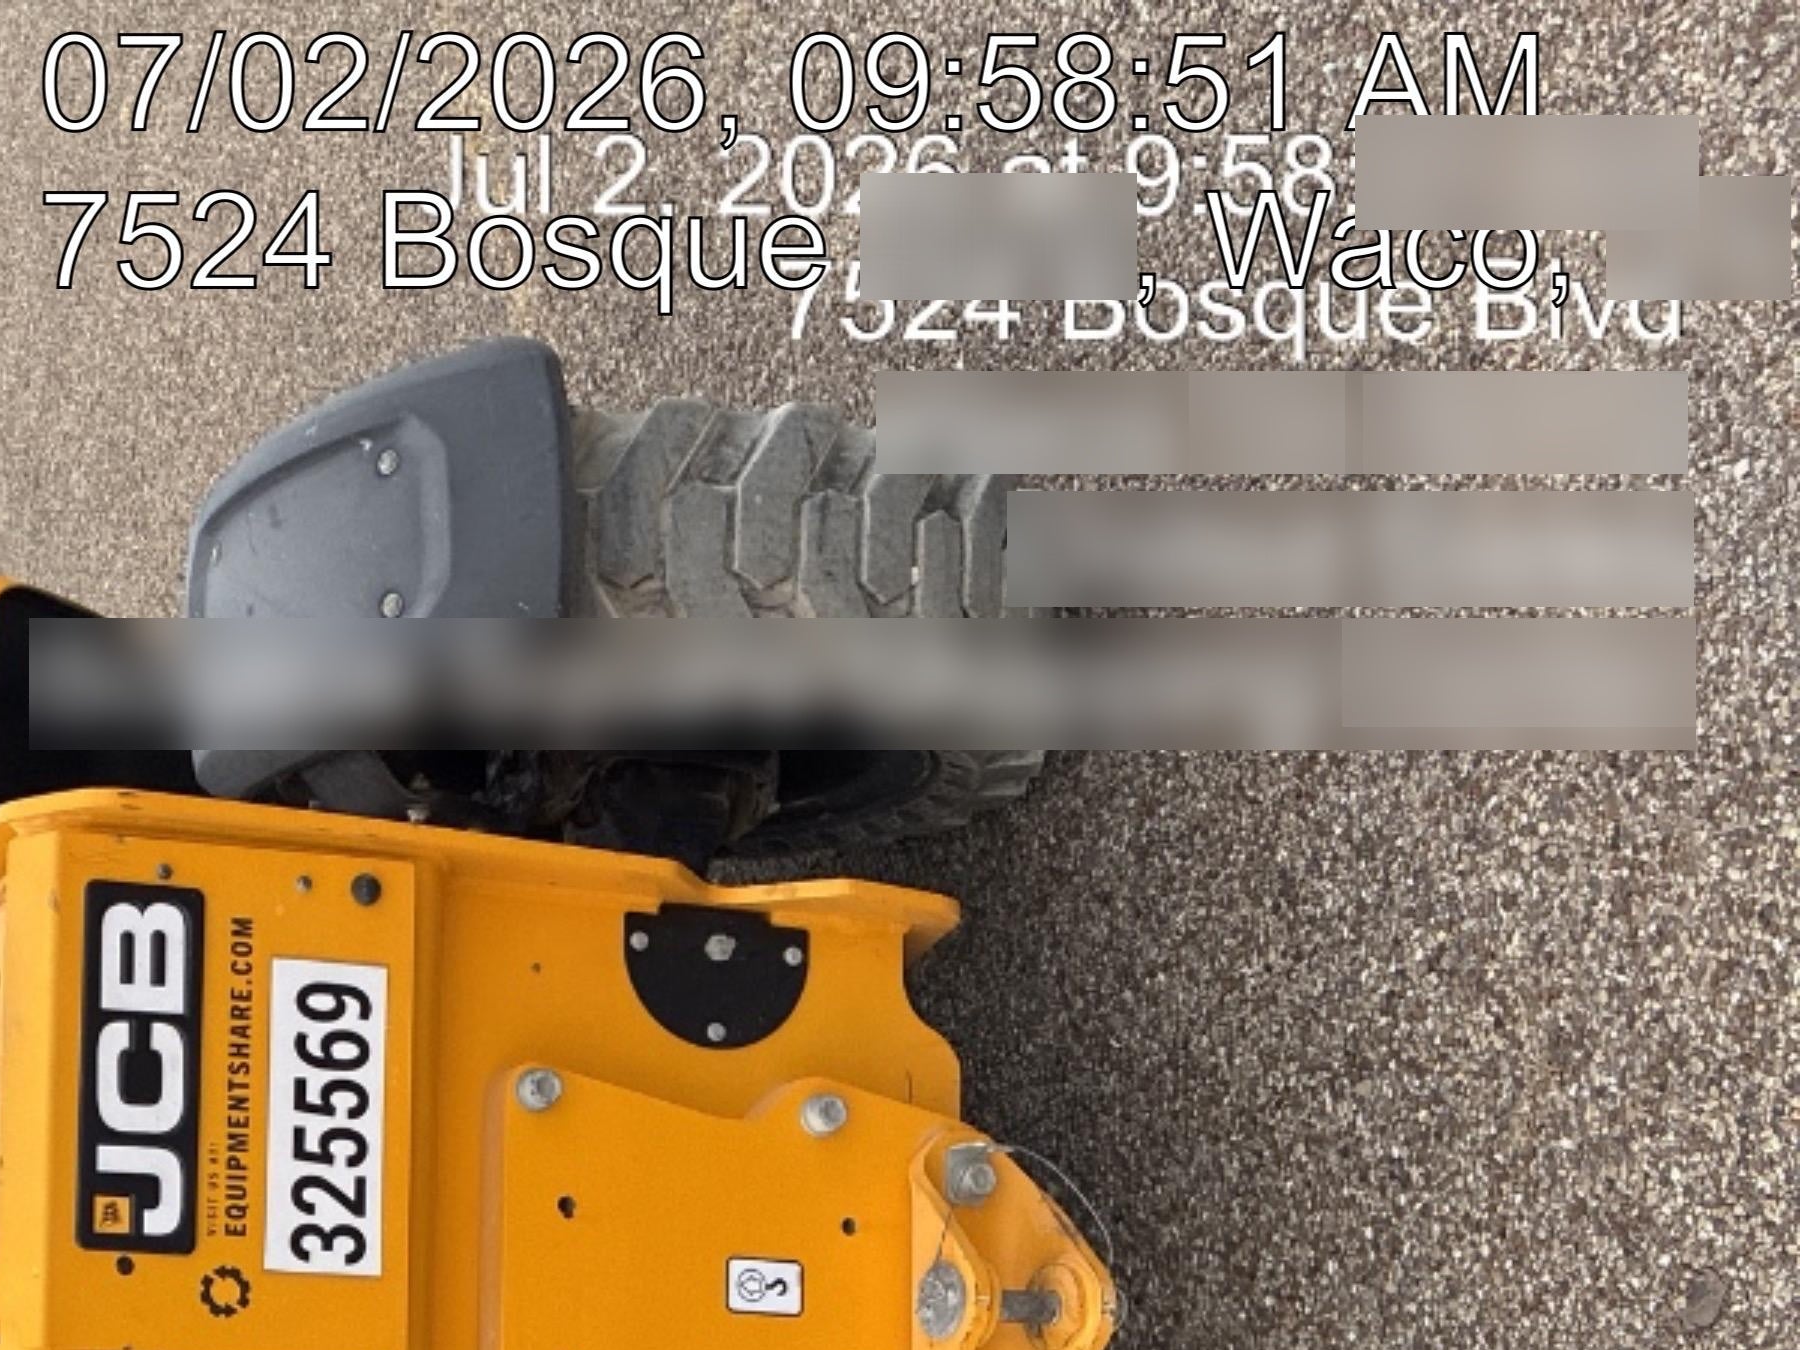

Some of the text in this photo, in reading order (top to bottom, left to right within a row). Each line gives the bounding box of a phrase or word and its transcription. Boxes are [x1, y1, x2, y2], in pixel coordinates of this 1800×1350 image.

[95, 902, 188, 1237] JCB
[224, 917, 254, 1238] EQUIPMENTSHARE.COM
[290, 981, 373, 1267] 325569
